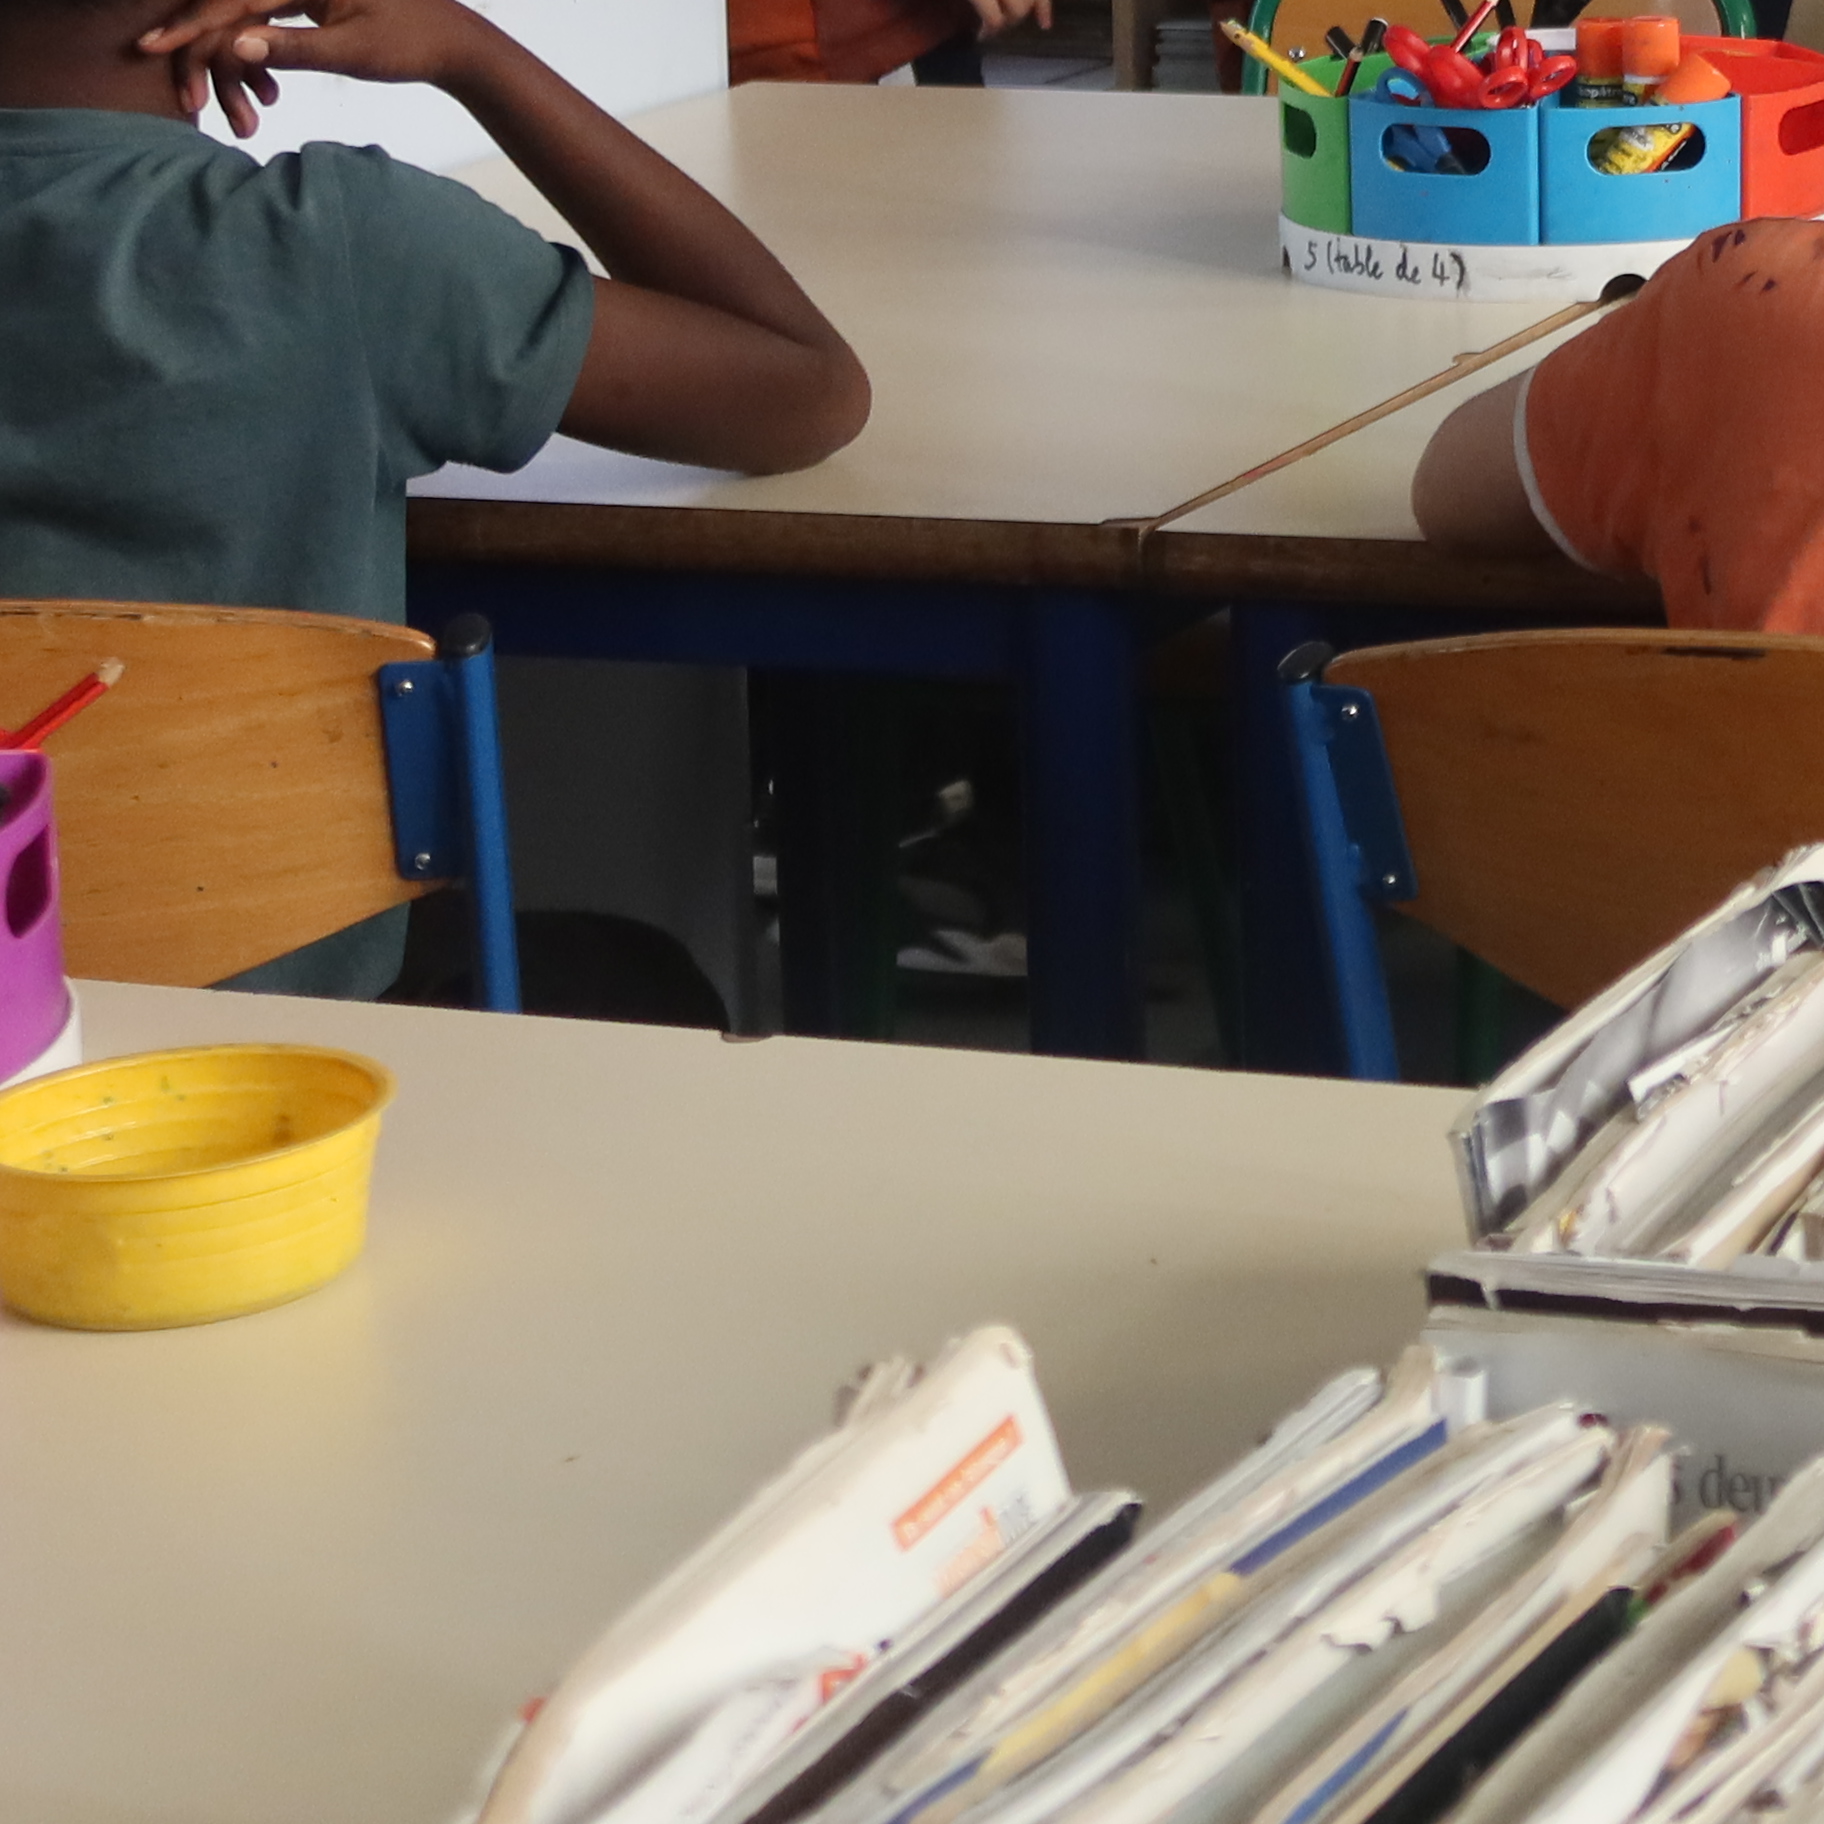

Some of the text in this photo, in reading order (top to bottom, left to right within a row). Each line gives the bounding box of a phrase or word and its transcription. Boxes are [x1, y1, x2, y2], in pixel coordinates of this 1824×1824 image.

[1303, 241, 1318, 271] 5
[1325, 238, 1385, 282] (table
[1395, 244, 1422, 286] de
